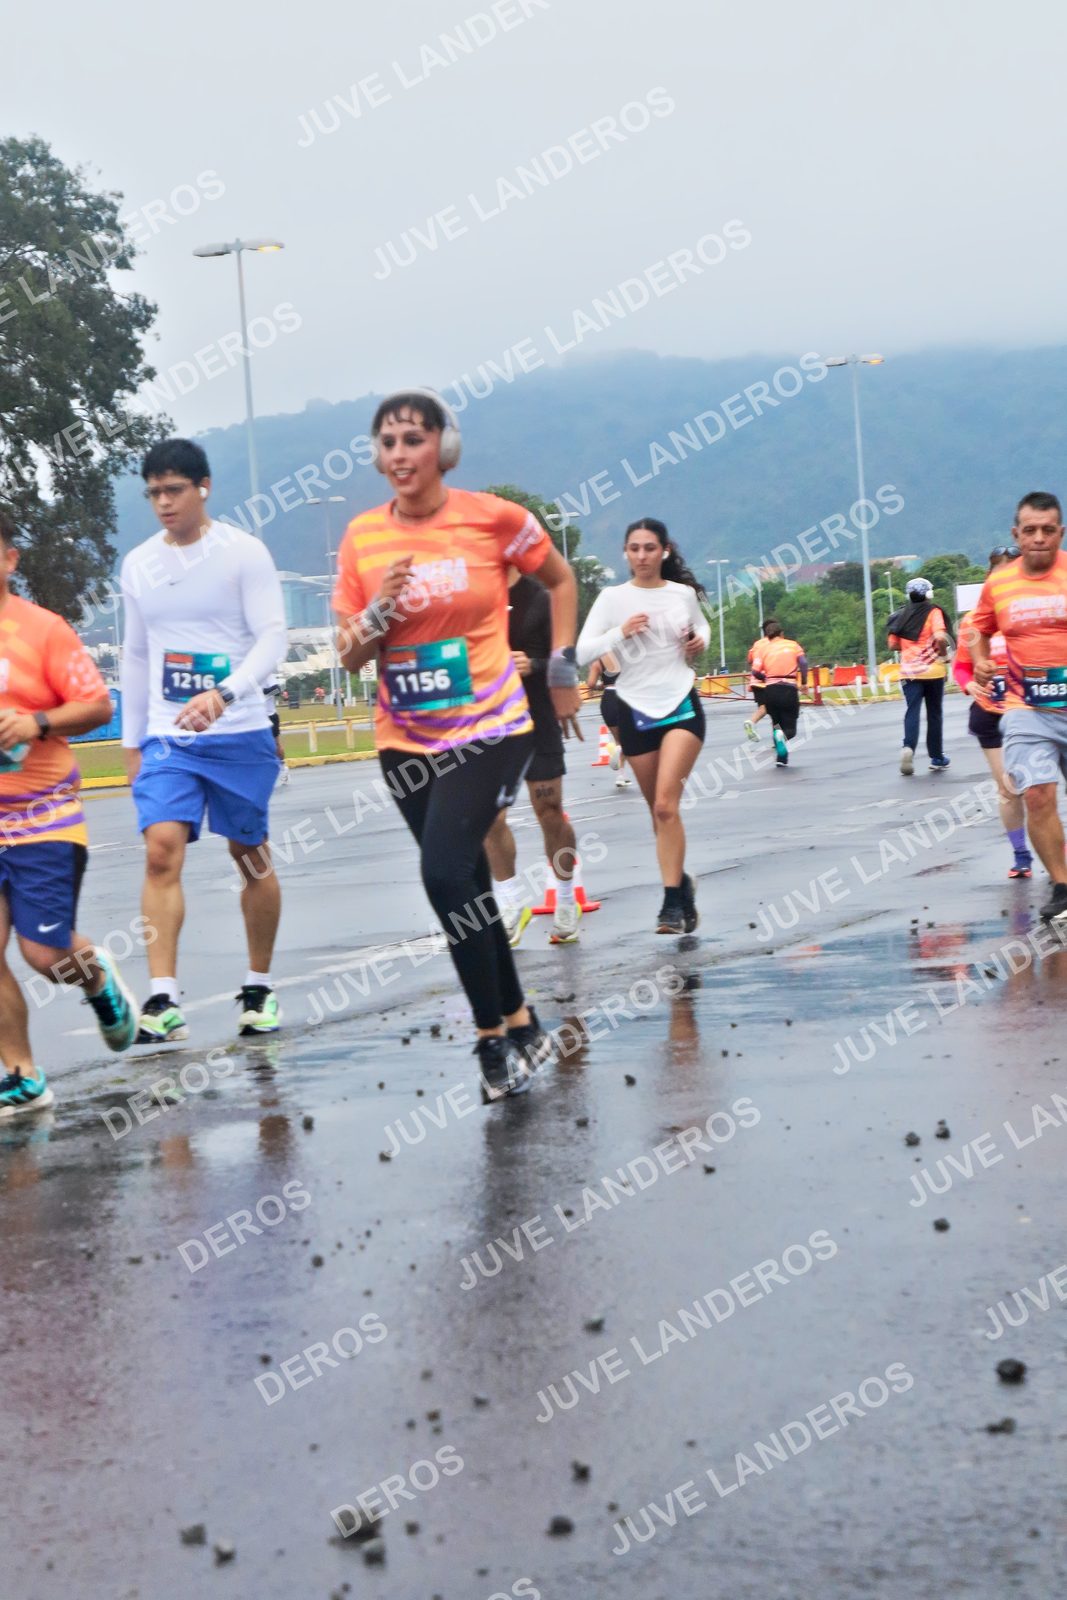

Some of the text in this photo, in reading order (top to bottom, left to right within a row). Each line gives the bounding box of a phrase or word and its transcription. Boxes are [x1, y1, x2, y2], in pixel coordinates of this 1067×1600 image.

[170, 671, 216, 691] 1216
[395, 668, 451, 694] 1156
[1031, 683, 1067, 697] 1683
